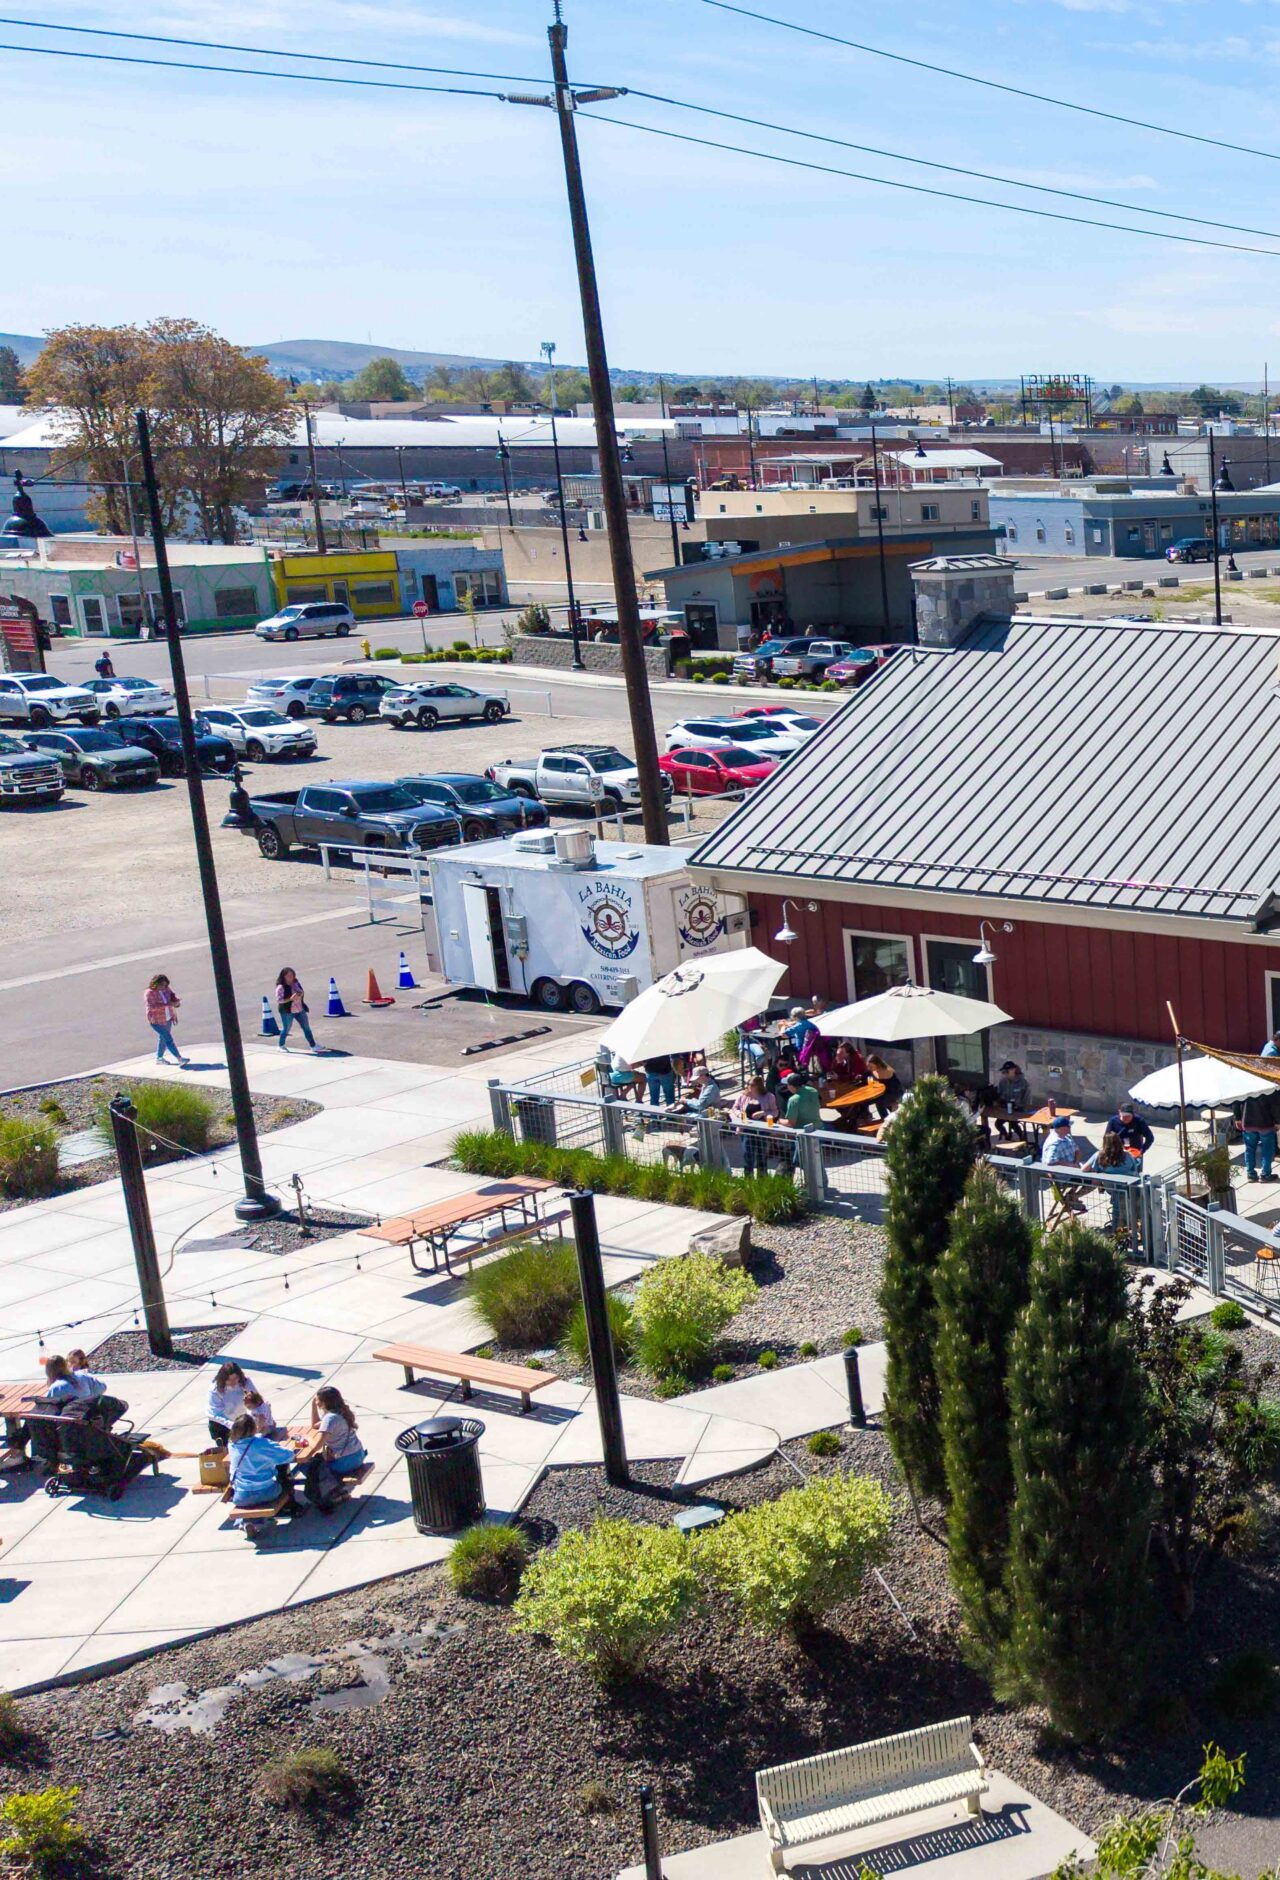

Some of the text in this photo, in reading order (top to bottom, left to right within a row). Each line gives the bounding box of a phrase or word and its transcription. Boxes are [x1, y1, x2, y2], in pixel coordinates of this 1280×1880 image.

[578, 881, 632, 908] LA BAHIA
[679, 892, 690, 907] LA
[590, 939, 631, 959] Mexican Food
